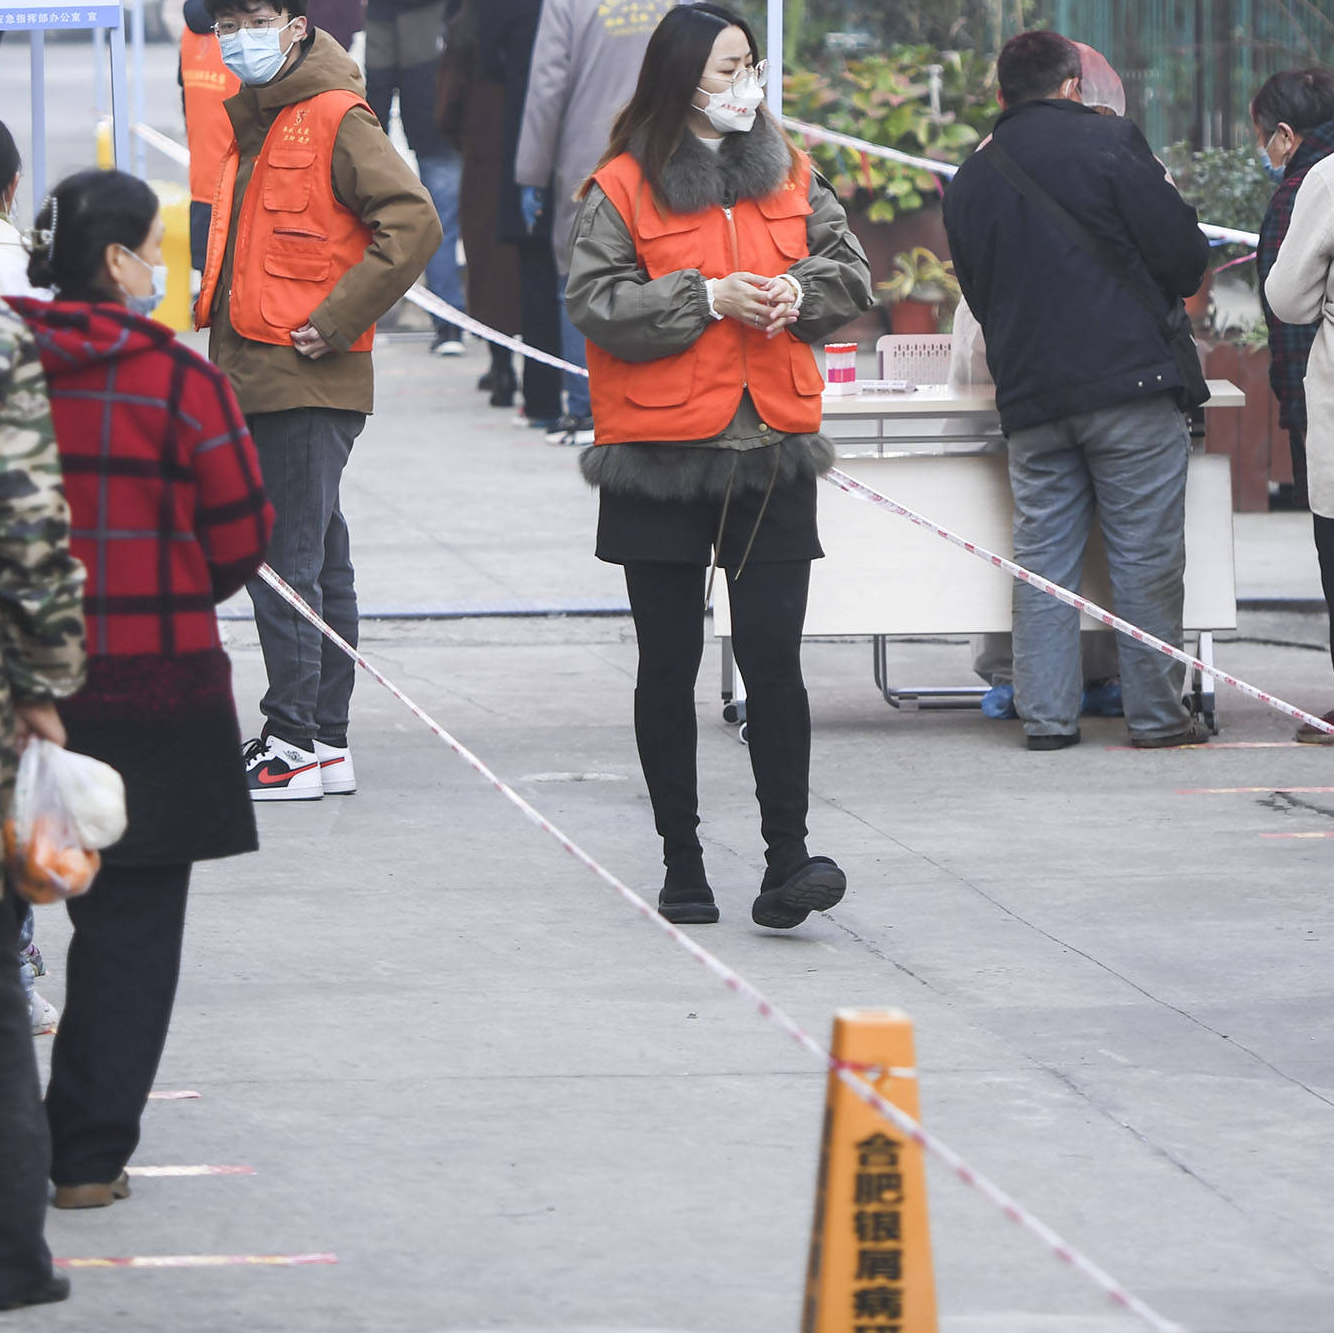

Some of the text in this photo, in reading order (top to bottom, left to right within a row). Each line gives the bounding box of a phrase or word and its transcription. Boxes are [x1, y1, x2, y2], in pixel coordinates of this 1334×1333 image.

[853, 1132, 904, 1333] 合肥银屑病
